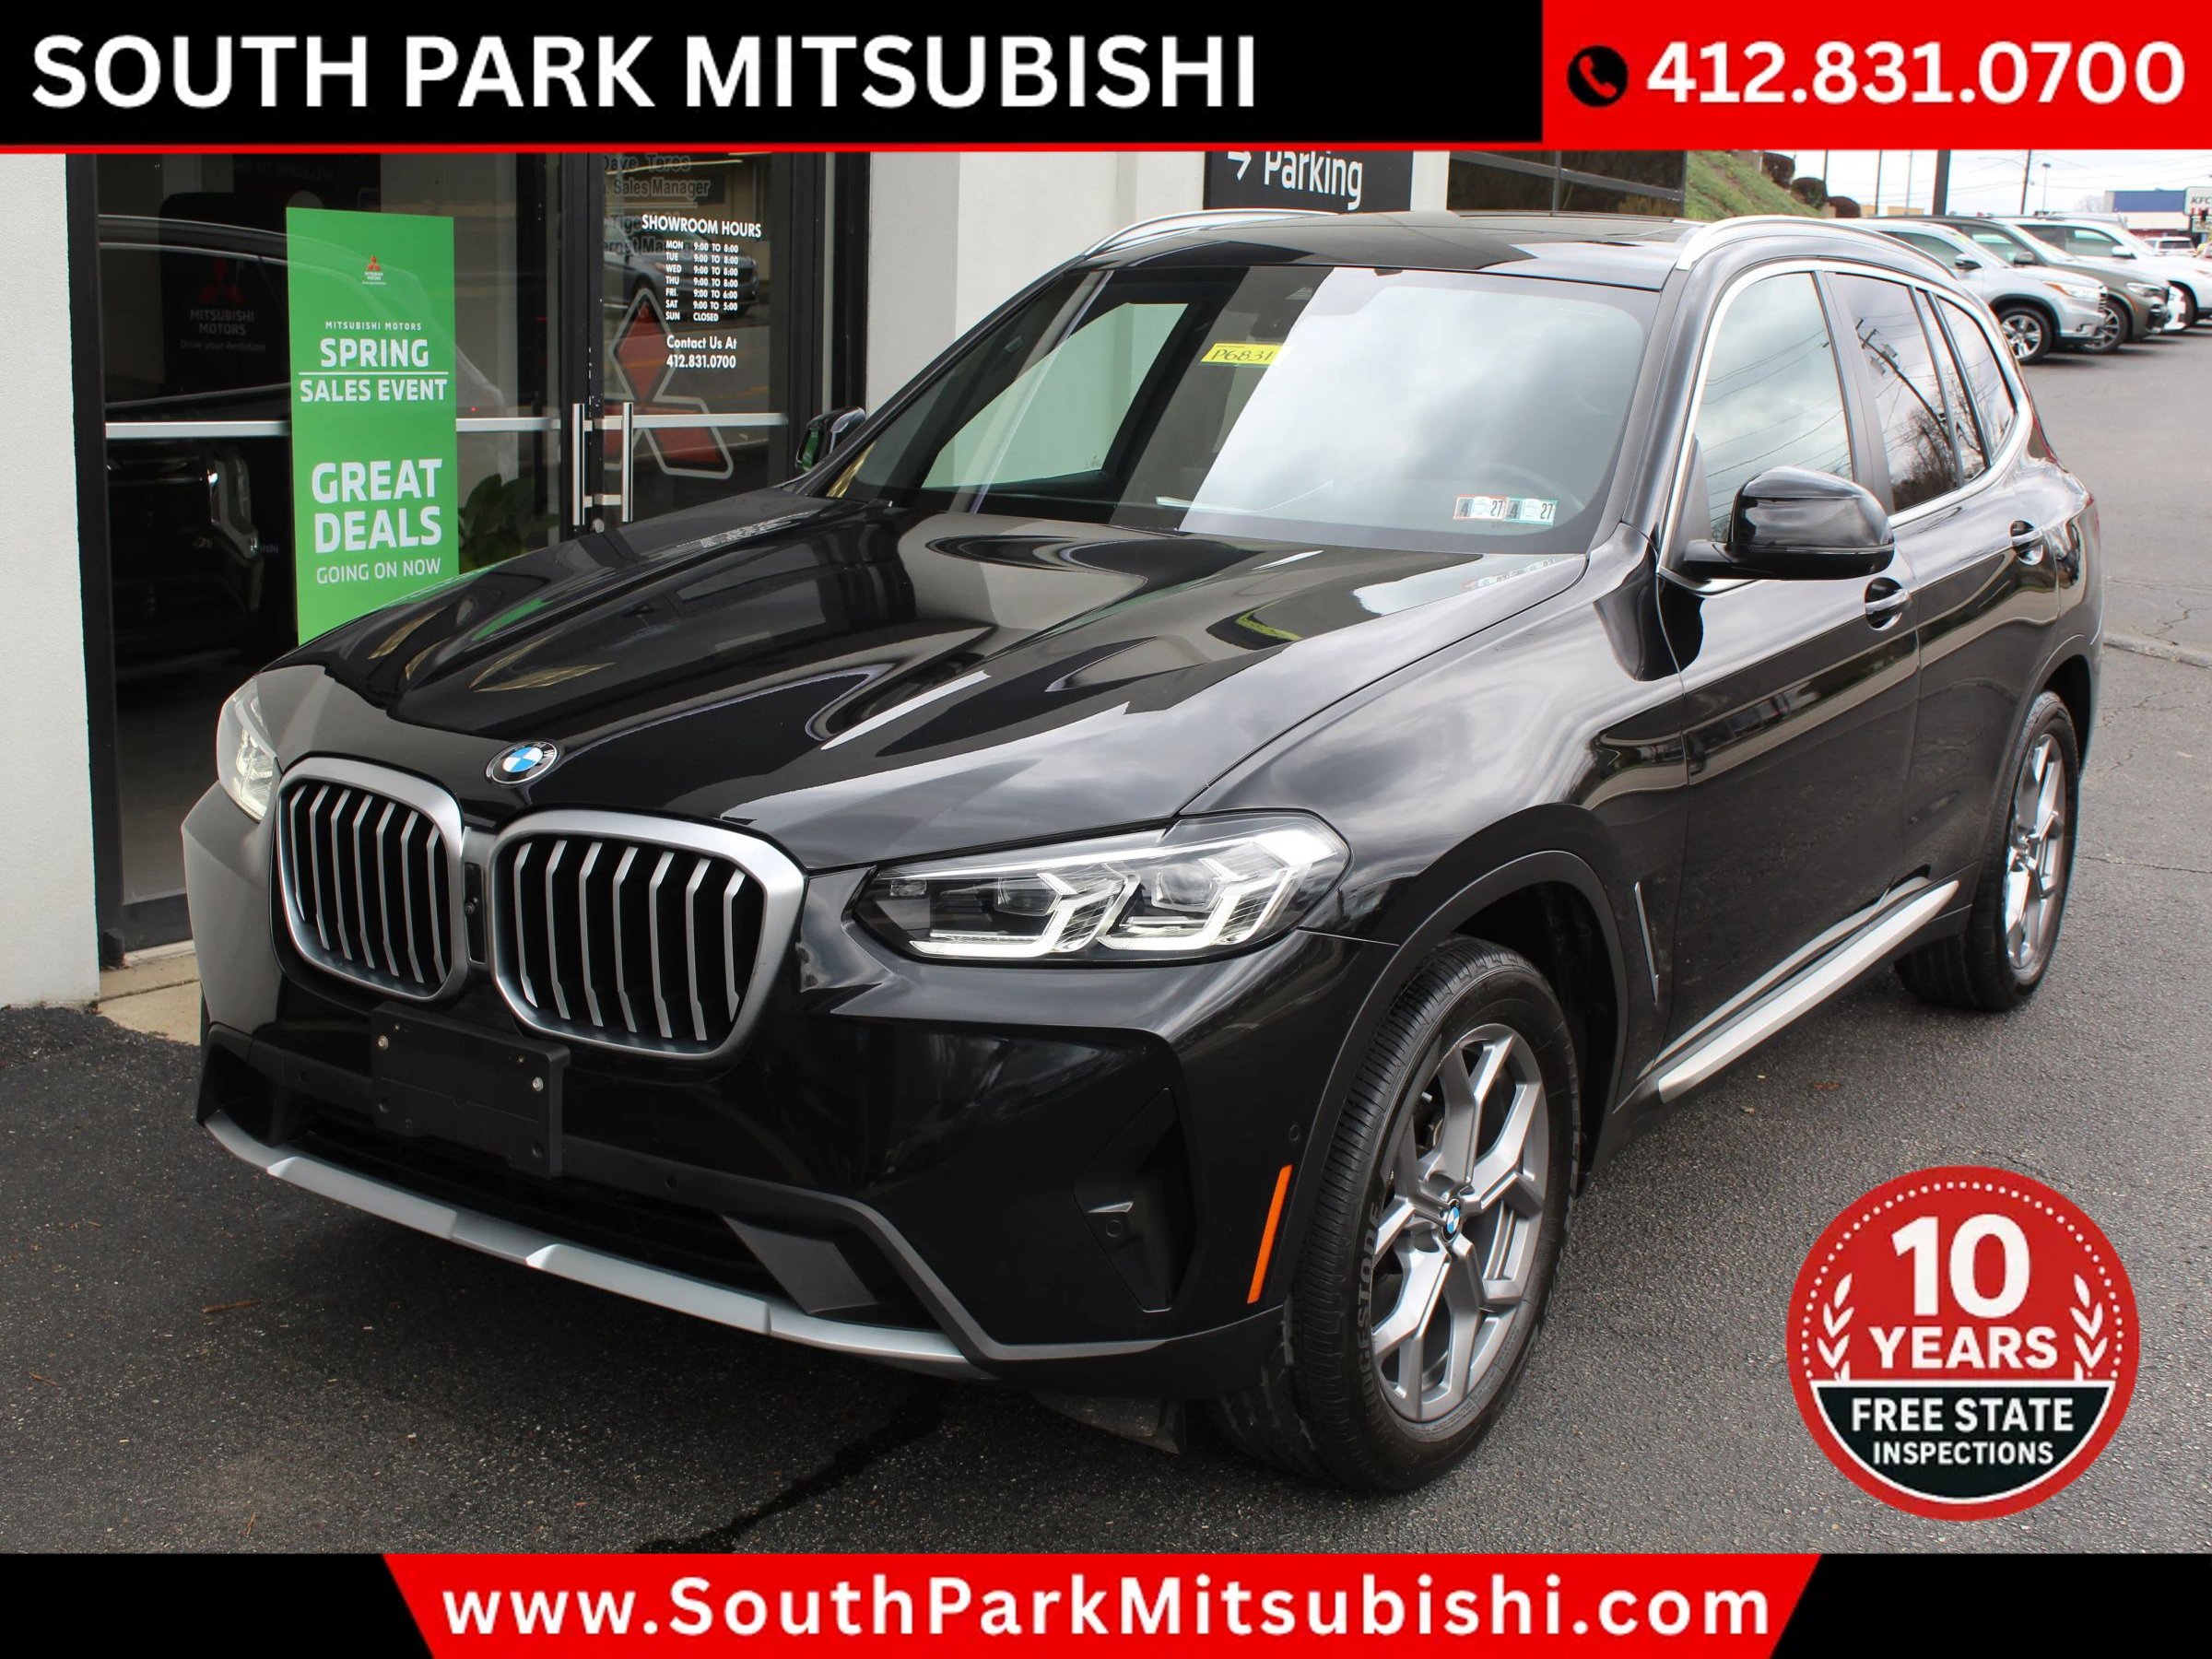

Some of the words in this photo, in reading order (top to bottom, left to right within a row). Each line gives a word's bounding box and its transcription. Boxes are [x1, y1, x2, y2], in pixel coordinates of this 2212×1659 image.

[1264, 150, 1363, 211] Parking
[615, 179, 649, 195] Sales
[653, 180, 710, 200] Manager
[2191, 195, 2211, 205] KFC
[641, 214, 719, 234] SHOWROOM
[722, 221, 762, 238] HOURS
[665, 241, 684, 250] MON
[694, 242, 709, 252] 9:00
[712, 243, 721, 253] TO
[724, 244, 739, 253] 8:00
[665, 253, 679, 262] TUE
[694, 254, 708, 264] 9:00
[712, 255, 721, 265] TO
[724, 256, 739, 265] 8:00
[665, 265, 682, 274] WED
[693, 265, 709, 276] 9:00
[712, 266, 721, 276] TO
[724, 267, 738, 276] 8:00
[665, 276, 680, 286] THU
[693, 277, 709, 287] 9:00
[712, 278, 721, 288] TO
[724, 279, 738, 288] 8:00
[693, 288, 708, 299] 9:00
[712, 289, 721, 299] TO
[723, 290, 738, 300] 6:00
[665, 300, 678, 309] SAT
[693, 300, 708, 310] 9:00
[711, 301, 720, 311] TO
[724, 302, 738, 312] 5:00
[189, 310, 254, 322] MITSUBISHI
[665, 312, 680, 321] SUN
[693, 312, 719, 322] CLOSED
[198, 324, 247, 335] MOTORS
[325, 322, 381, 330] MITSUBISHI
[385, 322, 422, 331] MOTORS
[666, 335, 707, 349] Contact
[710, 335, 723, 349] Us
[725, 336, 737, 350] At
[320, 338, 429, 368] SPRING
[1211, 348, 1274, 361] P6831
[666, 355, 736, 369] 412.831.0700
[300, 379, 371, 403] SALES
[378, 379, 448, 402] EVENT
[312, 458, 442, 504] GREAT
[1490, 500, 1503, 517] 27
[1540, 502, 1554, 520] 27
[314, 506, 442, 554] DEALS
[316, 563, 370, 584] GOING
[374, 560, 398, 579] ON
[403, 558, 441, 577] NOW
